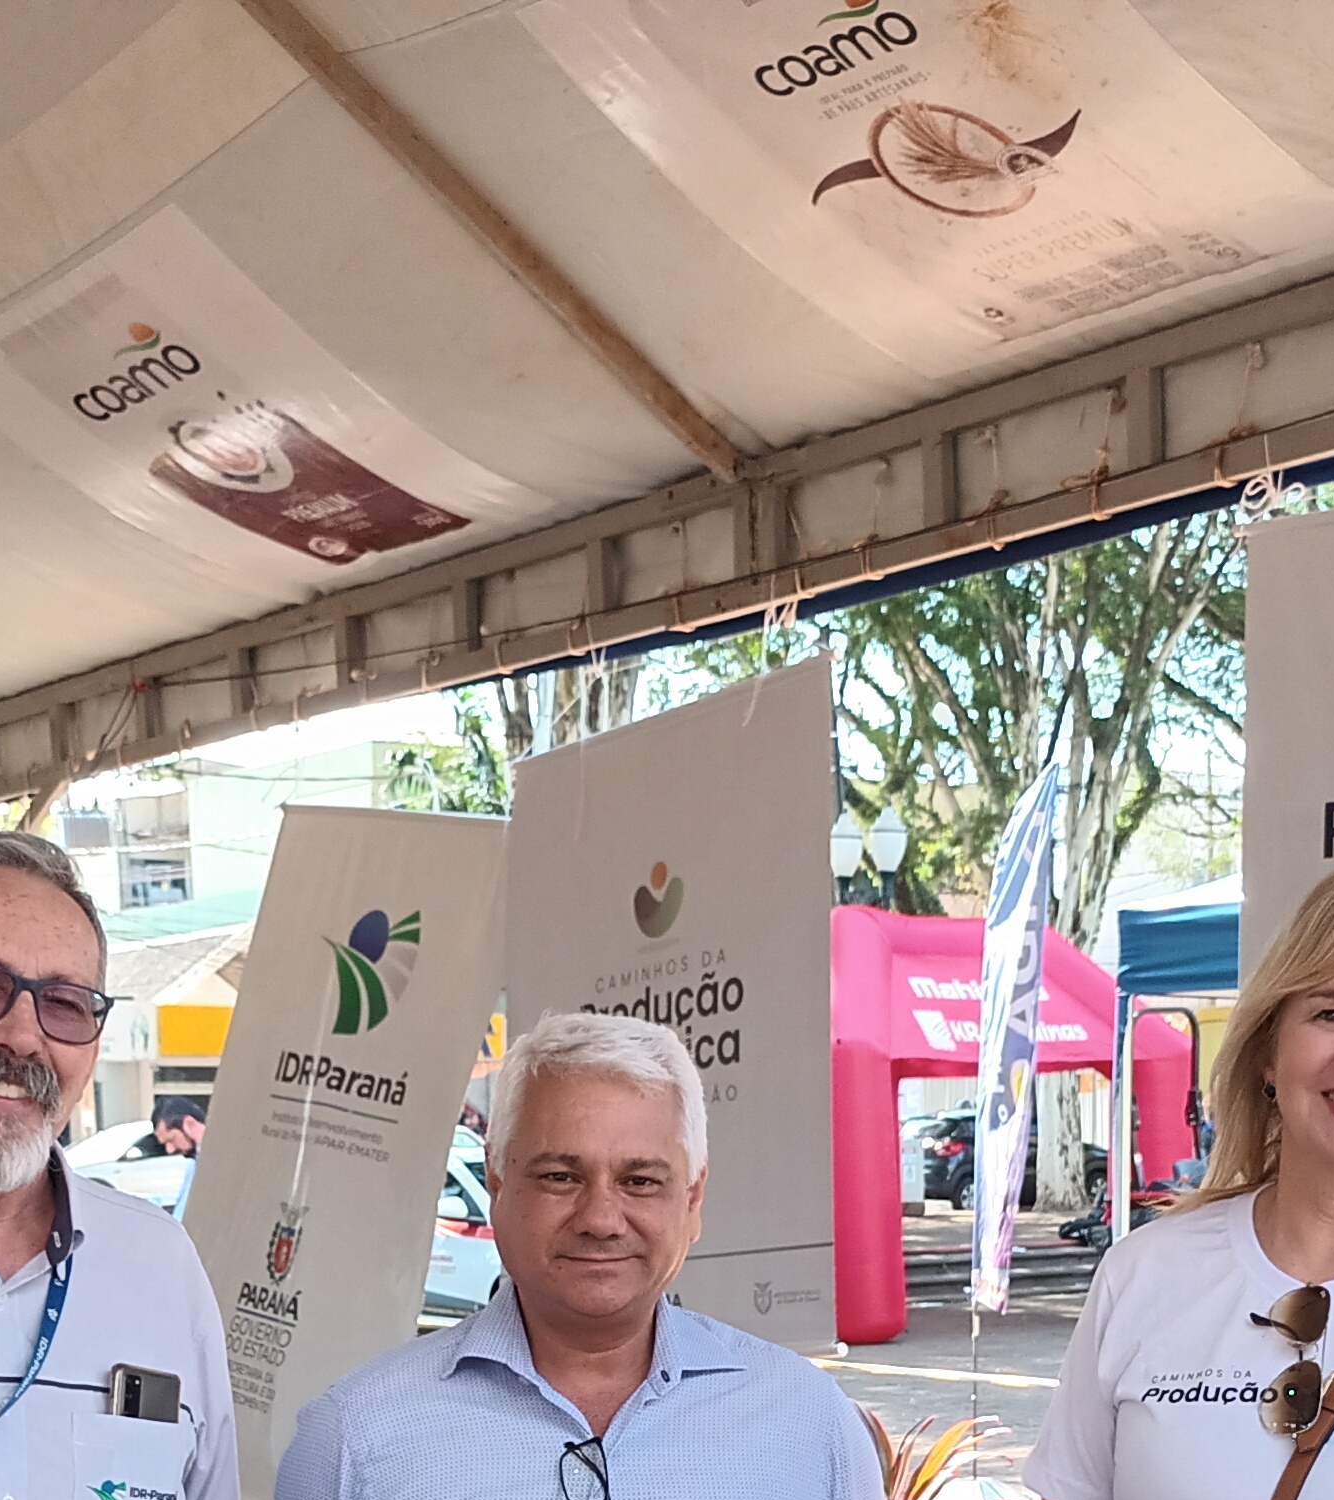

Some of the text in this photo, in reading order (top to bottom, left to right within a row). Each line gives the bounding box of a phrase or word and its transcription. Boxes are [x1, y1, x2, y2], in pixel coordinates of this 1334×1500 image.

[755, 12, 917, 96] coamo
[73, 343, 201, 421] coamo
[595, 948, 727, 994] CAMINHOS DA
[237, 1282, 302, 1321] PARANÁ
[229, 1314, 292, 1348] GOVERNO
[243, 1339, 286, 1367] ESTADO
[1141, 1381, 1279, 1406] Produção
[1151, 1368, 1252, 1384] CAMINHOS DA
